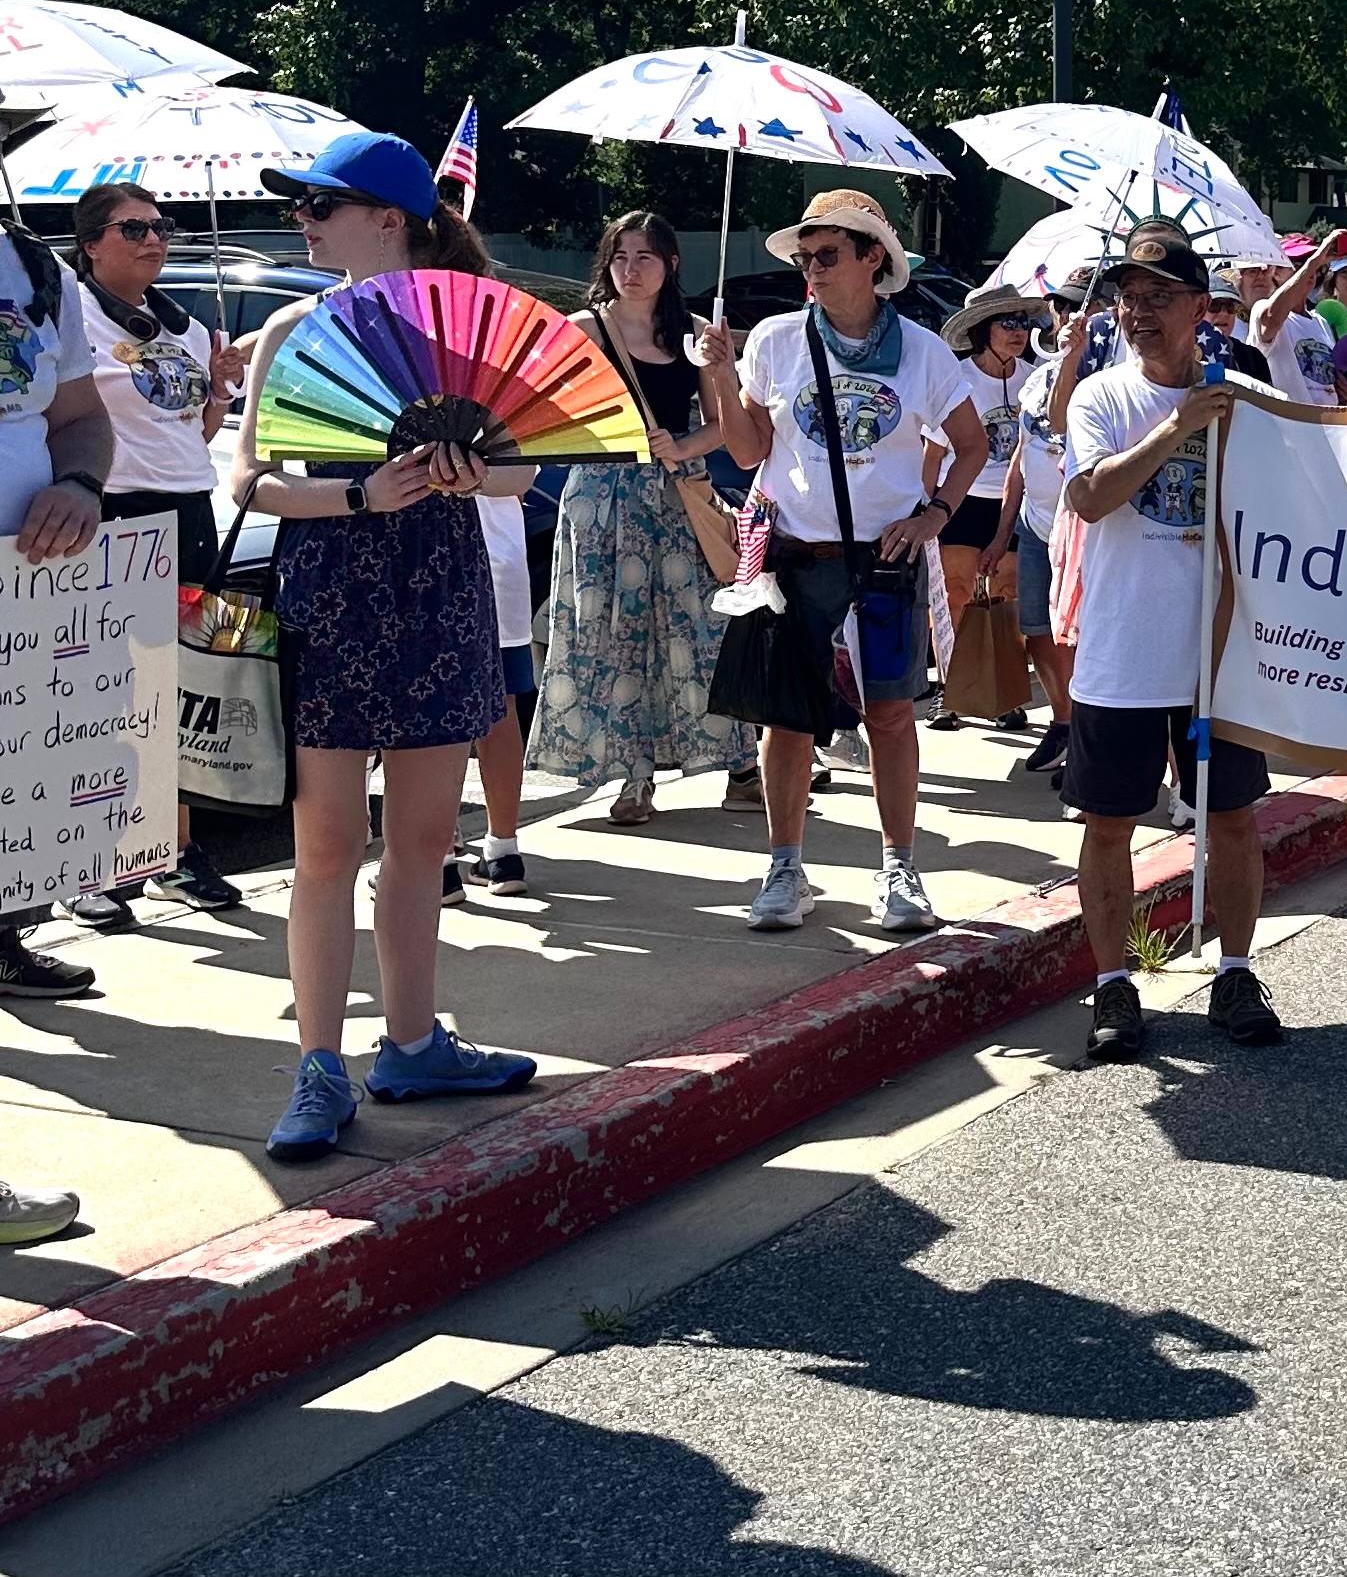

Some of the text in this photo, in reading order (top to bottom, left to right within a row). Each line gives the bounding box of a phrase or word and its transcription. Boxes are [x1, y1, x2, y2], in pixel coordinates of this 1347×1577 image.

[855, 382, 876, 395] 2026
[0, 528, 171, 599] ince 1776
[54, 603, 87, 645] all
[97, 601, 136, 641] for
[1255, 621, 1345, 661] Building
[47, 666, 73, 697] to
[96, 667, 136, 692] our
[1257, 659, 1299, 685] more
[44, 692, 160, 748] democracy!
[178, 687, 221, 734] TA
[178, 733, 232, 753] yland
[32, 782, 46, 800] a
[71, 767, 128, 794] more
[57, 824, 84, 843] on
[103, 802, 145, 831] the
[0, 841, 171, 902] nity of all humans
